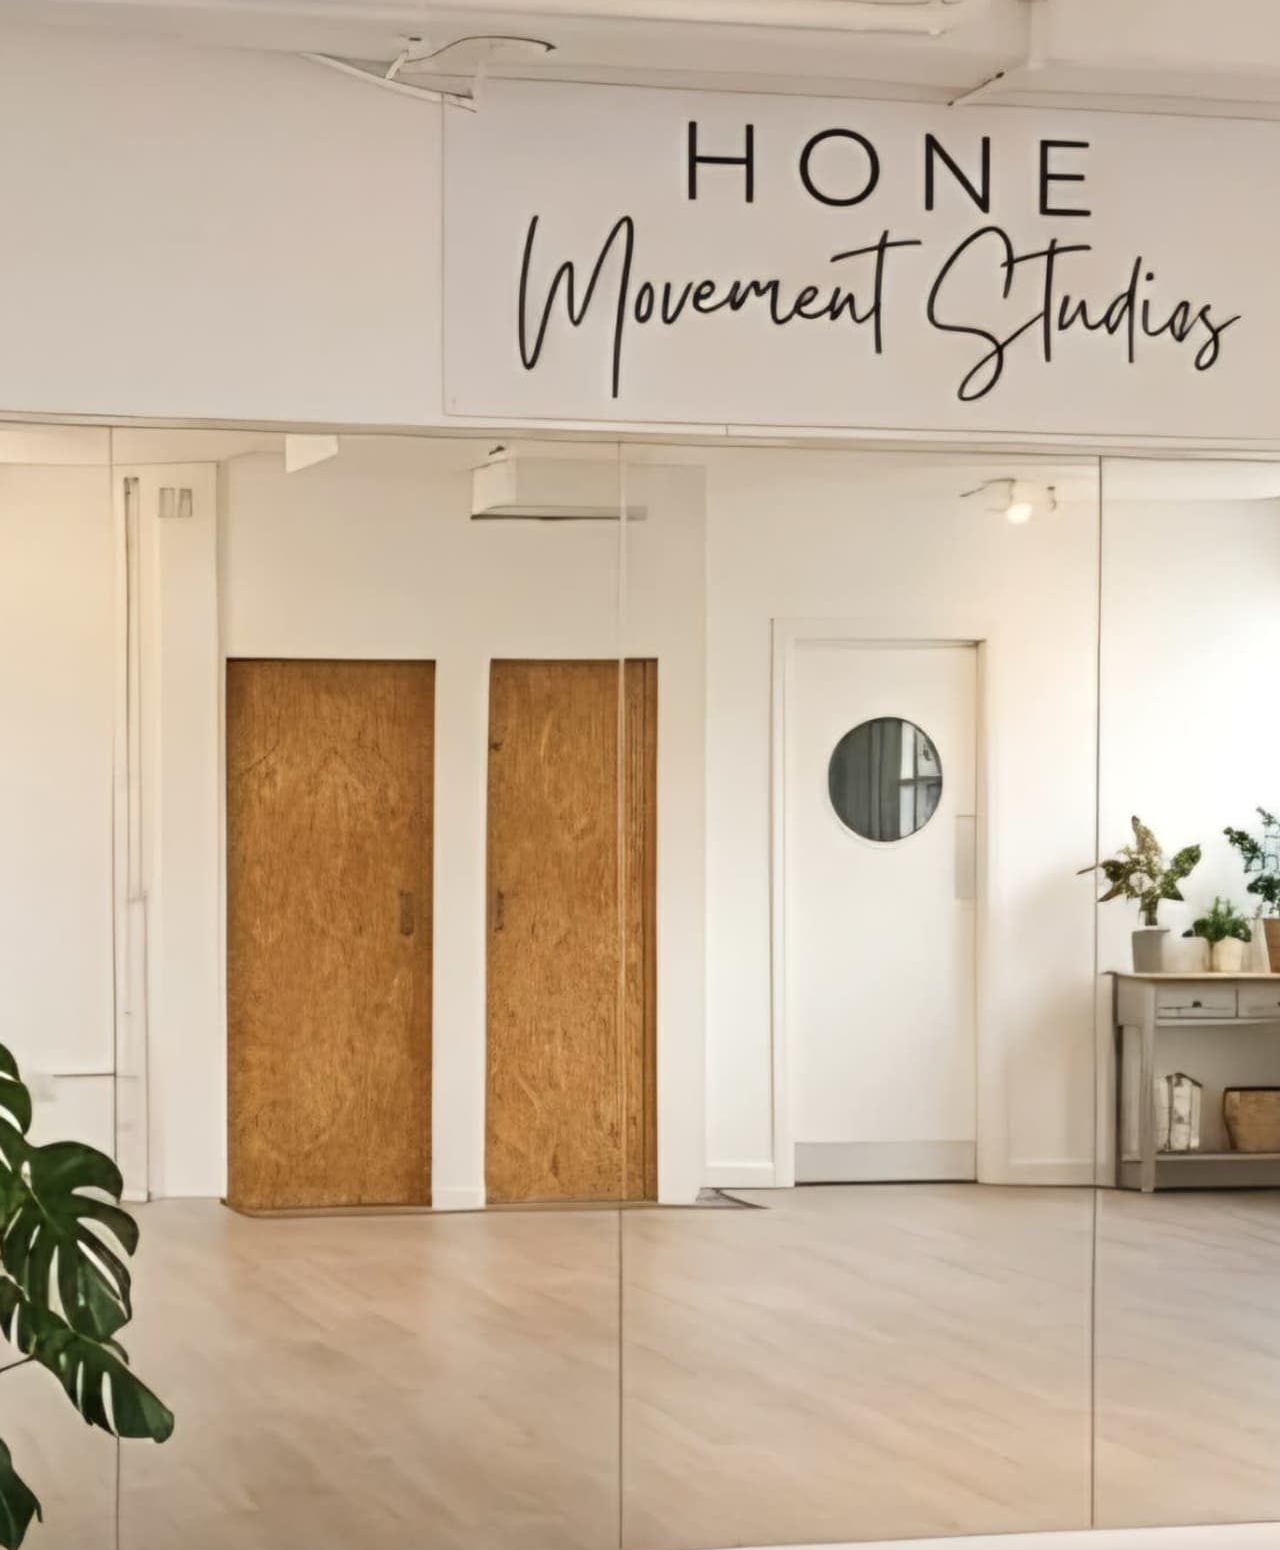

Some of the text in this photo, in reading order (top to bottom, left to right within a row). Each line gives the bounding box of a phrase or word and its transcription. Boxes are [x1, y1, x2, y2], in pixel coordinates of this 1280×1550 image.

[687, 120, 1093, 217] HONE
[518, 215, 1242, 402] Movement Studios
